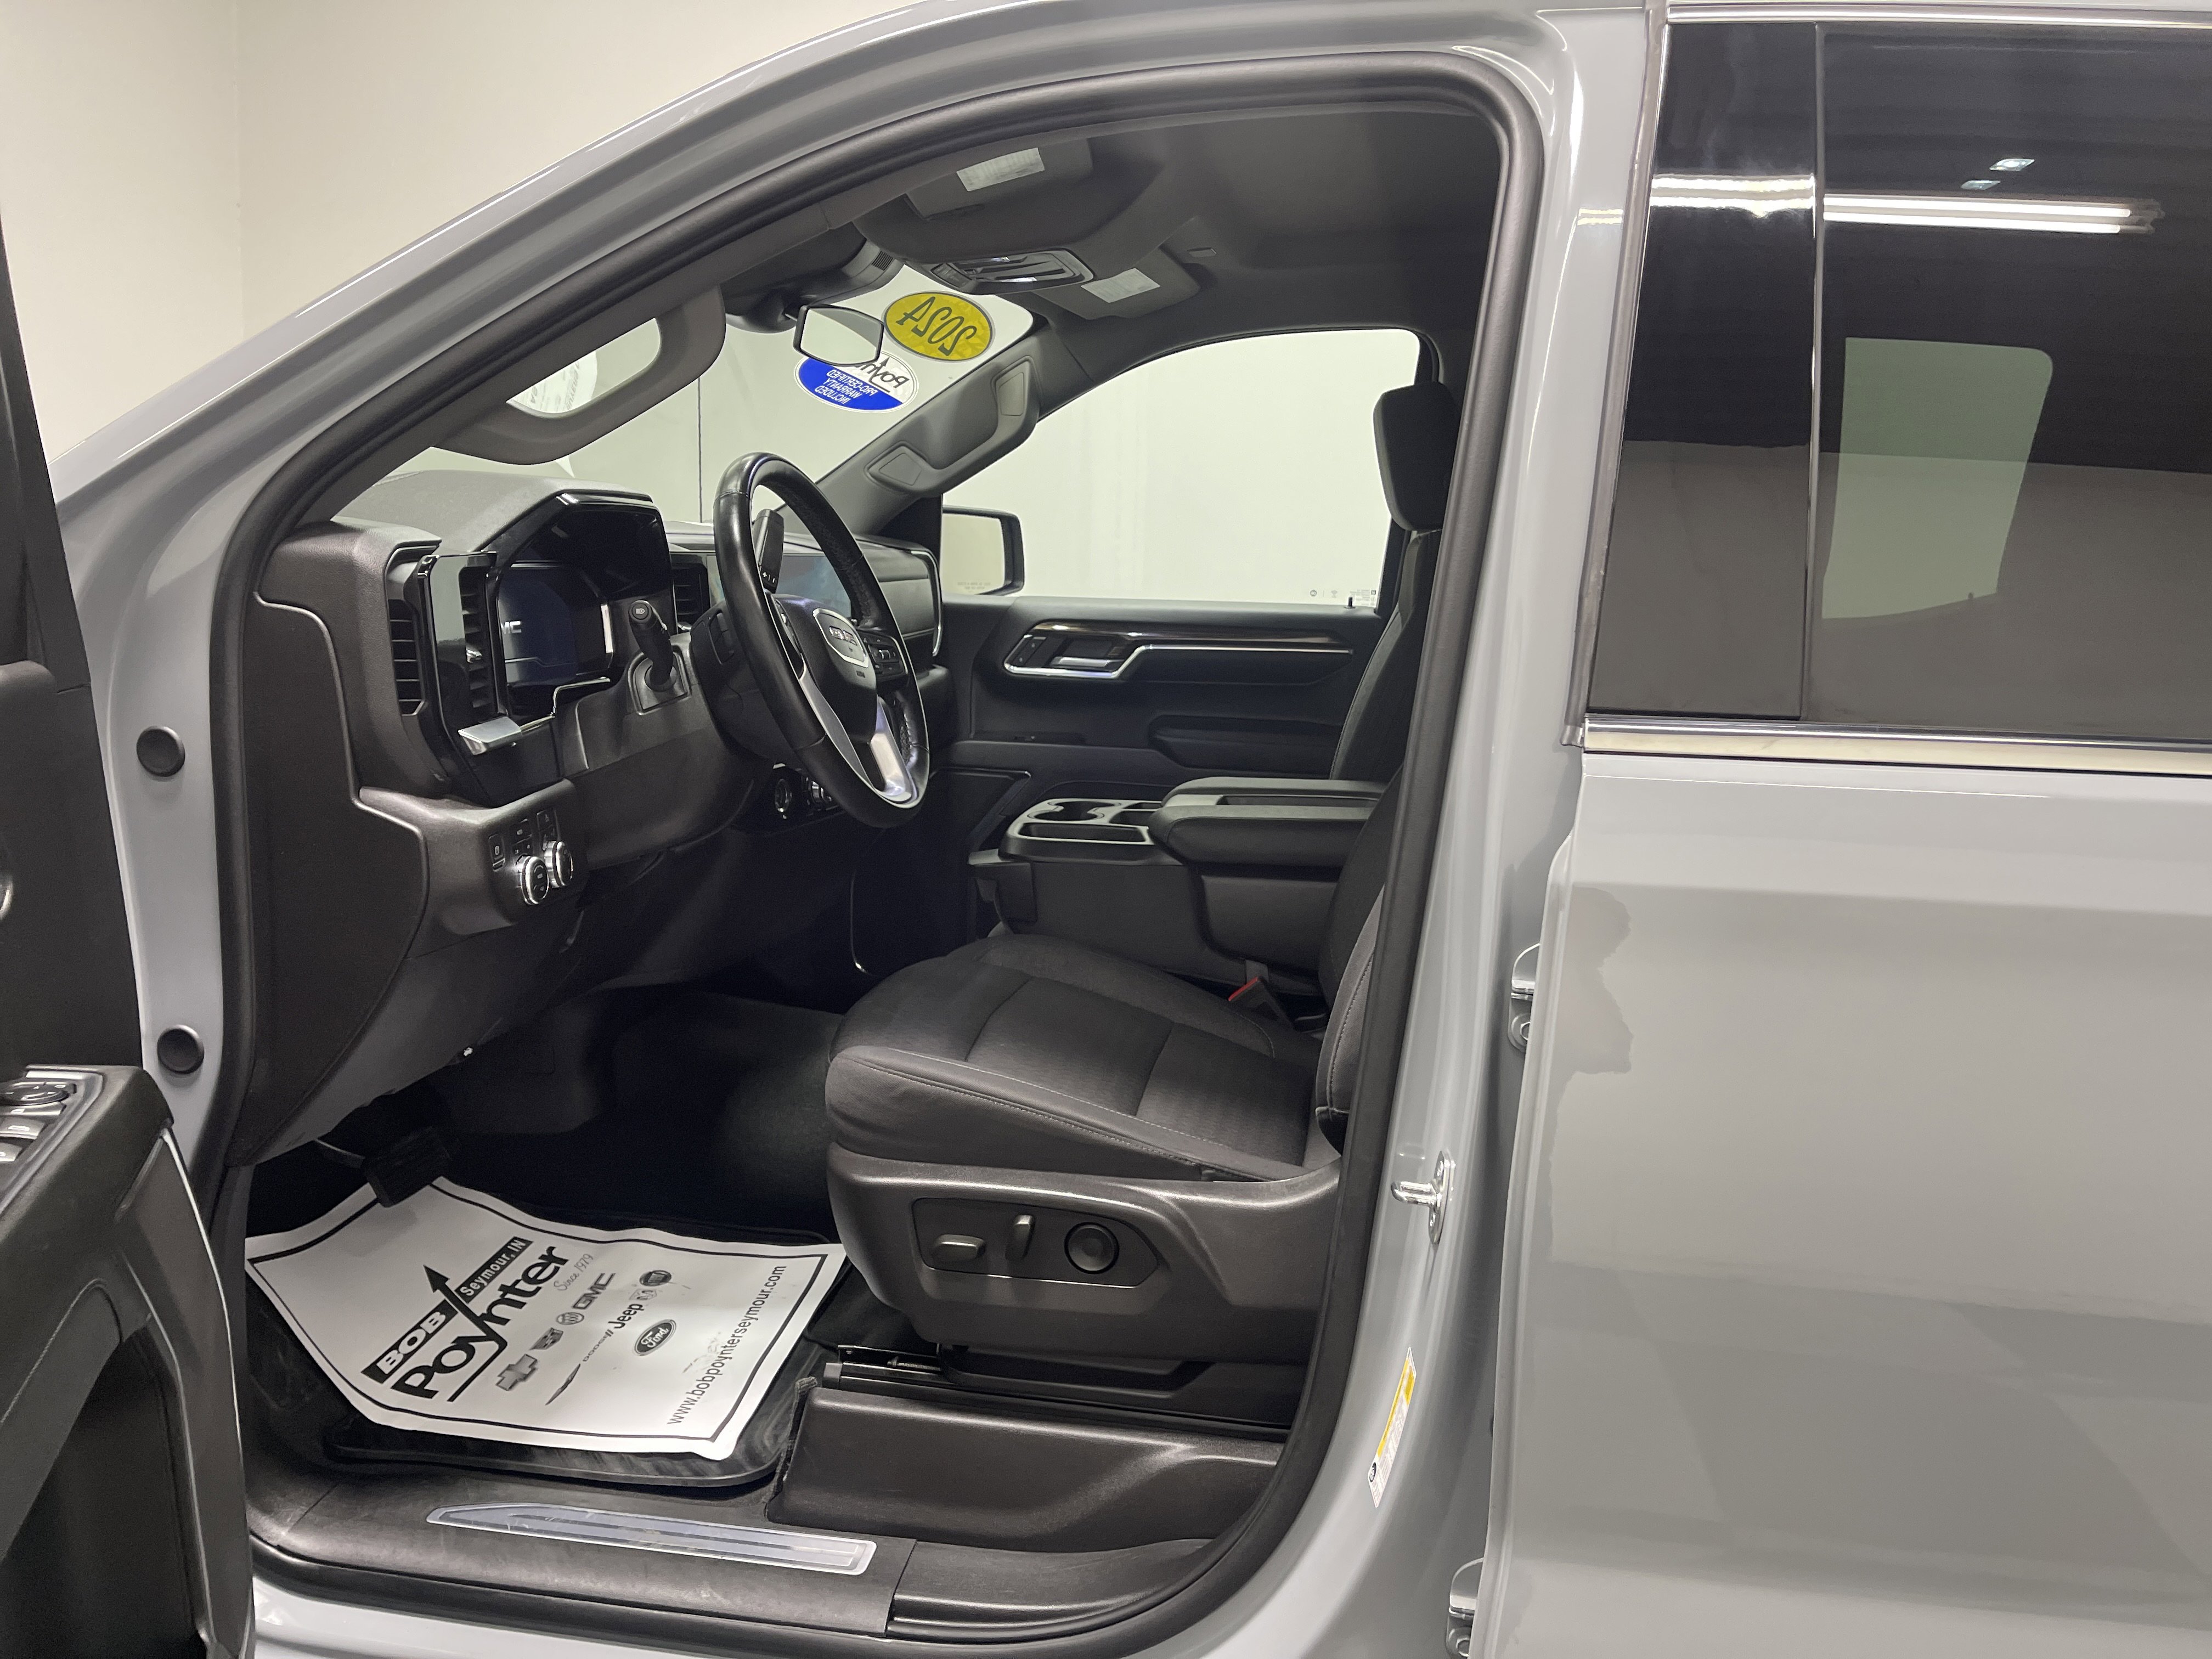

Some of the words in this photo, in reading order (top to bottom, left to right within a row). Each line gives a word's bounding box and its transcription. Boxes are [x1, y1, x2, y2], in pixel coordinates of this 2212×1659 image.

[500, 620, 522, 634] MC
[459, 1253, 515, 1296] Seymour,
[507, 1239, 526, 1252] IN
[553, 1272, 580, 1291] Since
[574, 1254, 594, 1272] 1979
[572, 1272, 616, 1310] GMC
[390, 1246, 569, 1402] Poynter
[607, 1304, 645, 1329] Jeep
[376, 1311, 447, 1375] BOB
[640, 1327, 669, 1348] Ford
[667, 1265, 787, 1425] www.bobpoynterseymour.com
